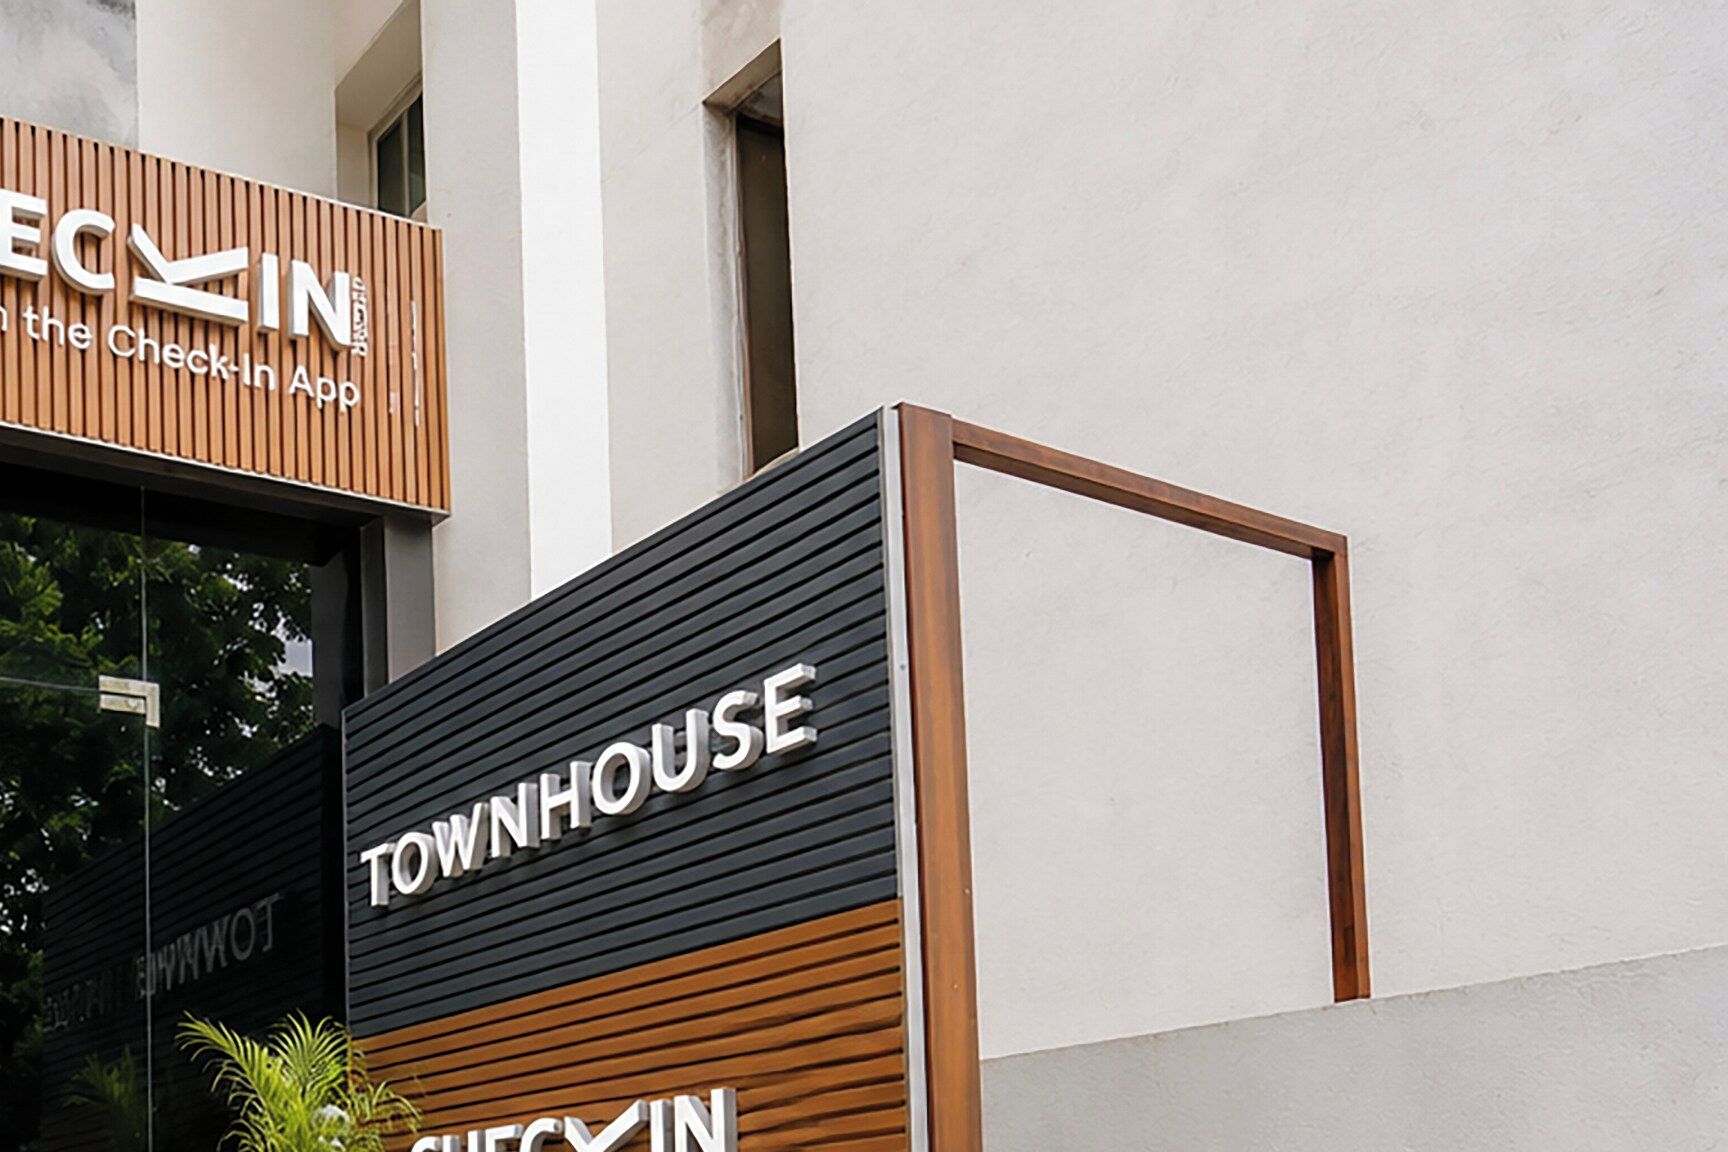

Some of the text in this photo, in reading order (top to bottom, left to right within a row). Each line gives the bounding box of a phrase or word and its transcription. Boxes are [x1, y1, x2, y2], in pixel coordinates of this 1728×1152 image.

[23, 304, 94, 351] the
[107, 324, 277, 392] Check-In
[287, 363, 361, 413] App
[360, 662, 818, 908] TOWNHOUSE
